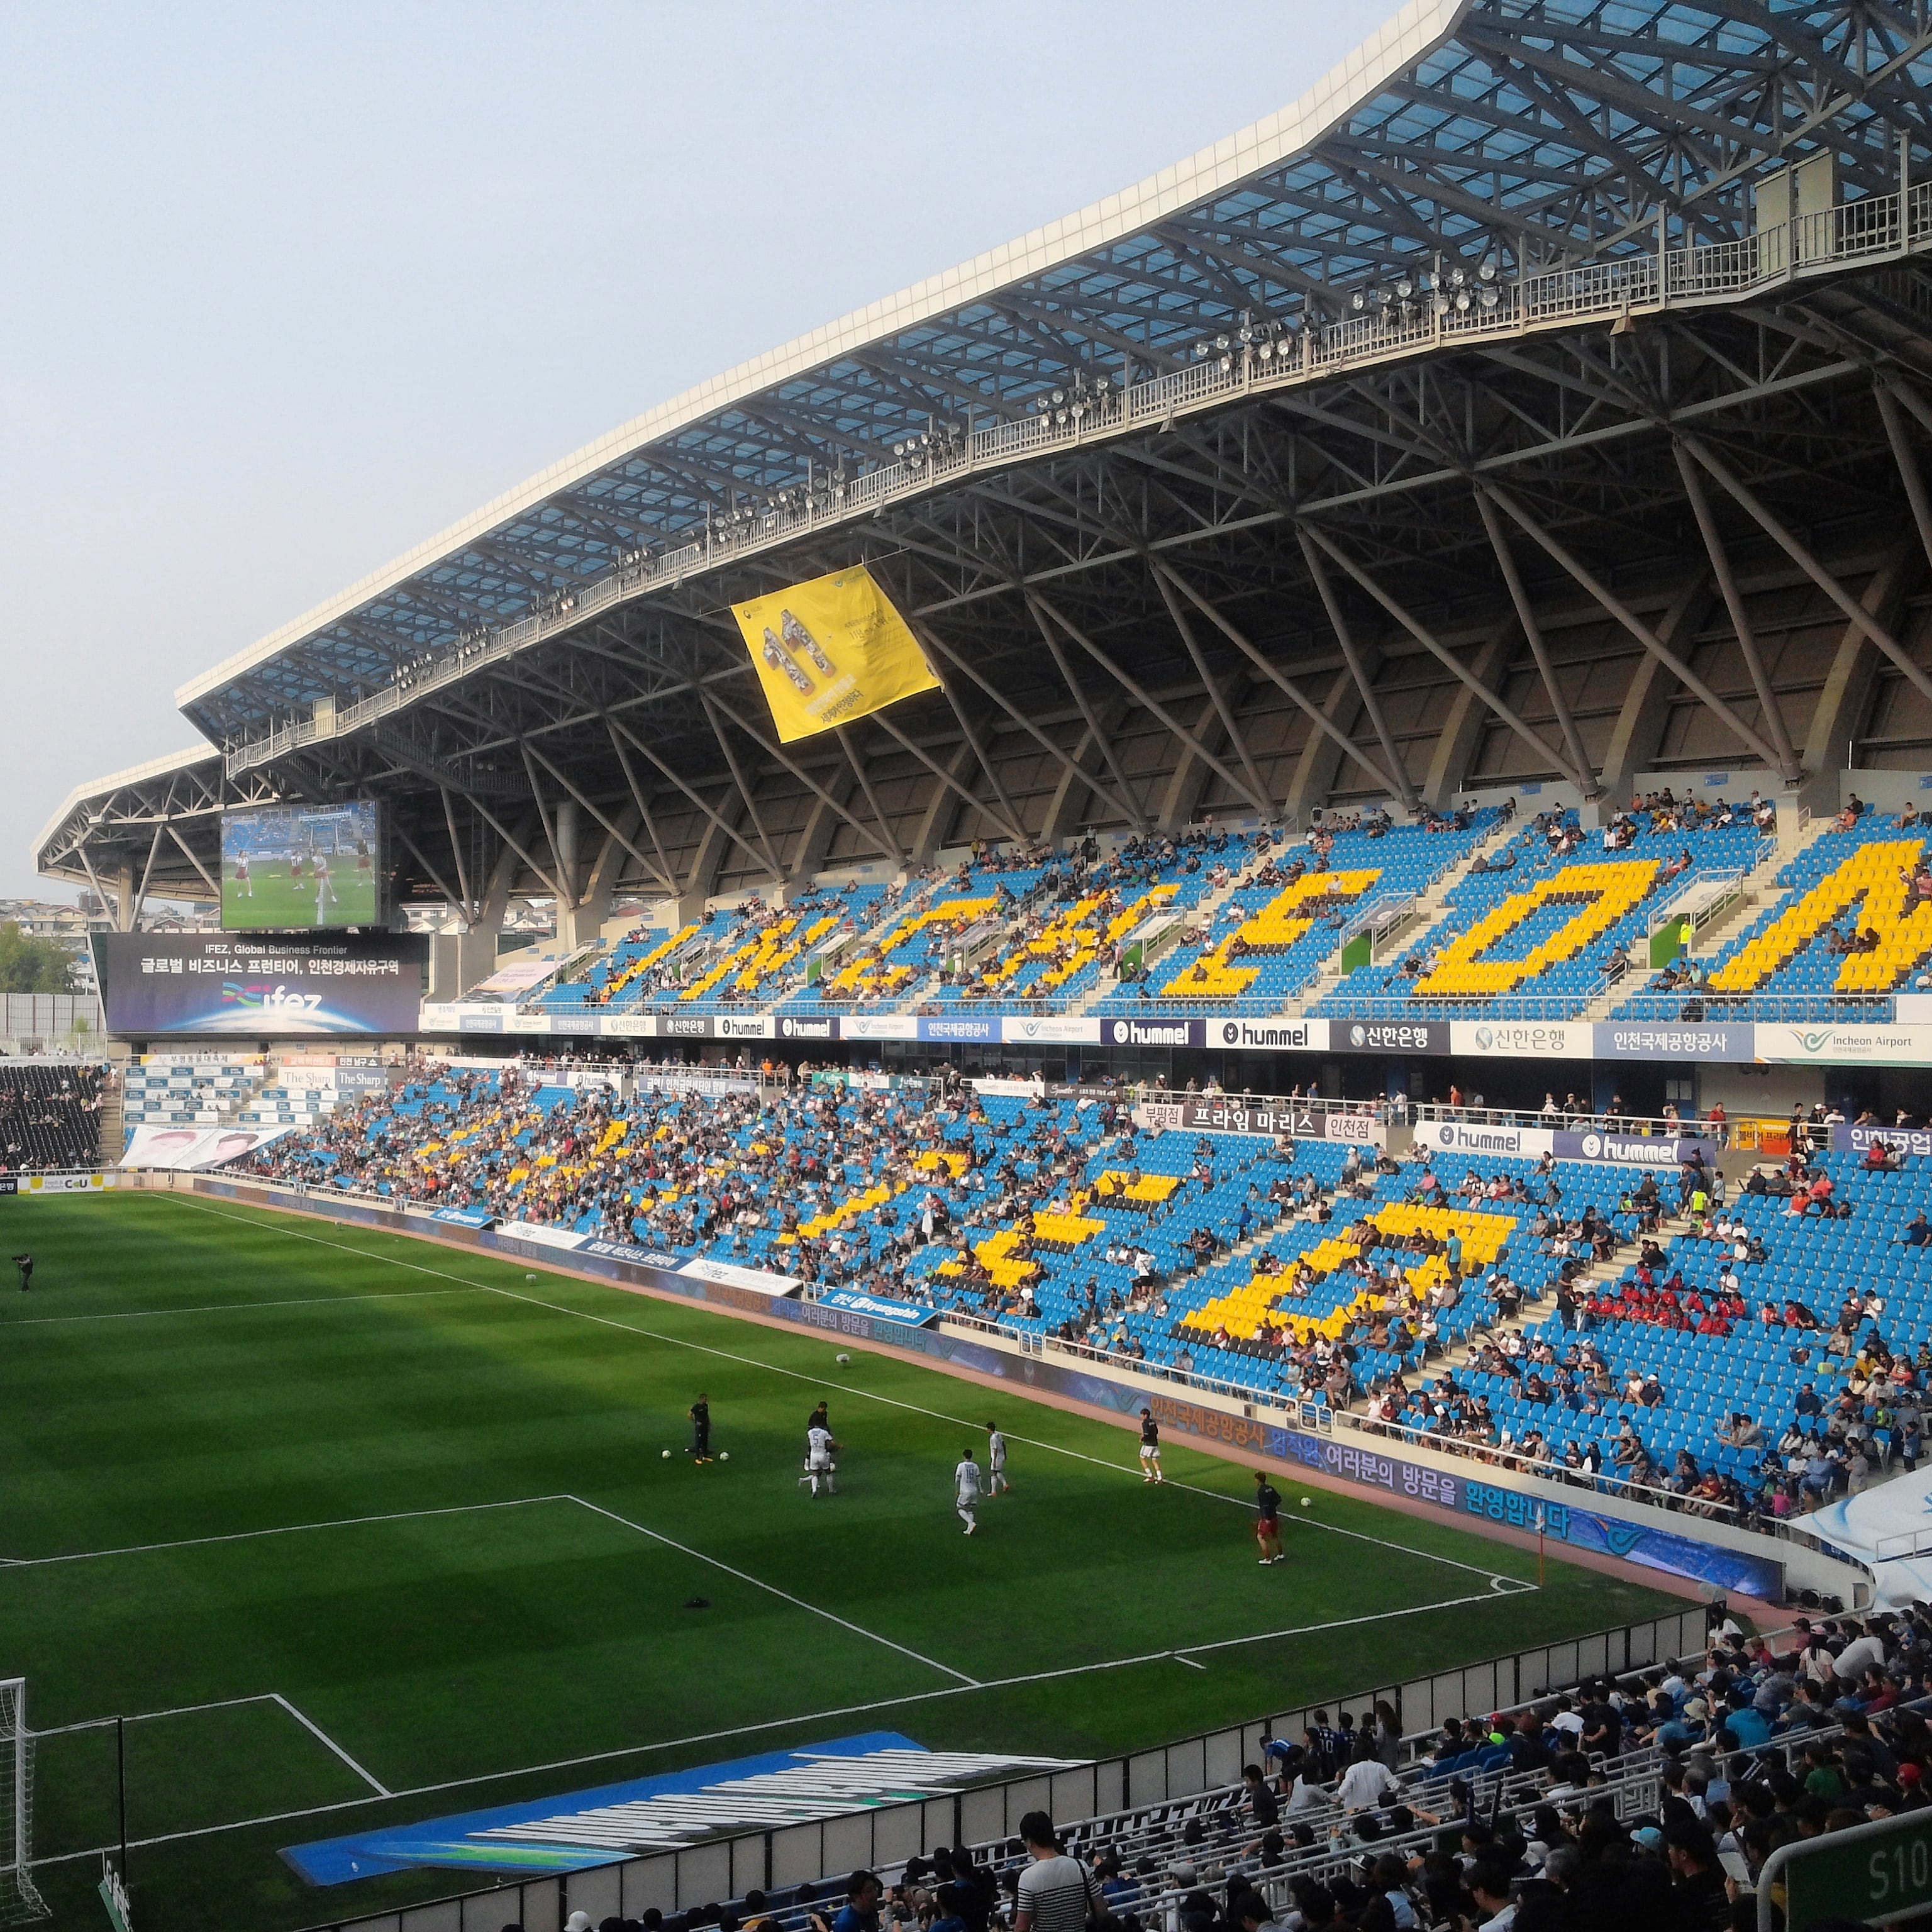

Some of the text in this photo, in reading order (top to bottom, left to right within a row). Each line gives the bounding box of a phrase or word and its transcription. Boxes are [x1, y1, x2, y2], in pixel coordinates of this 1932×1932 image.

[205, 945, 348, 955] IFEZ, Global Business Frontier
[140, 958, 399, 975] 글로벌 비즈니스 프런티어, 인천경제자유구역
[263, 984, 323, 1010] ifez
[618, 1018, 656, 1033] 신한은행
[674, 1019, 706, 1035] 신한은행
[731, 1019, 765, 1036] hummel
[792, 1019, 830, 1038] hummel
[928, 1022, 990, 1038] 인천국제공항공사
[1130, 1023, 1190, 1045] hummel
[1241, 1023, 1308, 1046] hummel
[1366, 1026, 1428, 1049] 신한은행
[1495, 1028, 1566, 1051] 신한은행
[1613, 1031, 1728, 1053] 인천국제공항공사
[1833, 1035, 1913, 1050] Incheon Airport
[284, 1072, 304, 1084] The
[340, 1072, 381, 1087] The Sharp
[1145, 1106, 1179, 1125] 부평점
[1192, 1108, 1316, 1135] 프라임 마리스
[1330, 1118, 1369, 1139] 인천점
[1457, 1133, 1521, 1152] hummel
[1603, 1136, 1680, 1163] hummel
[587, 1241, 616, 1255] 글로벌
[612, 1246, 645, 1261] 비즈니스
[831, 1292, 857, 1308] 경신
[802, 1302, 838, 1330] 여러분의
[841, 1316, 870, 1337] 방문을
[1150, 1396, 1267, 1450] 인천국제공항공사
[1326, 1445, 1394, 1488] 여러분의
[1402, 1464, 1457, 1506] 방문을
[1465, 1480, 1572, 1540] 환영합니다
